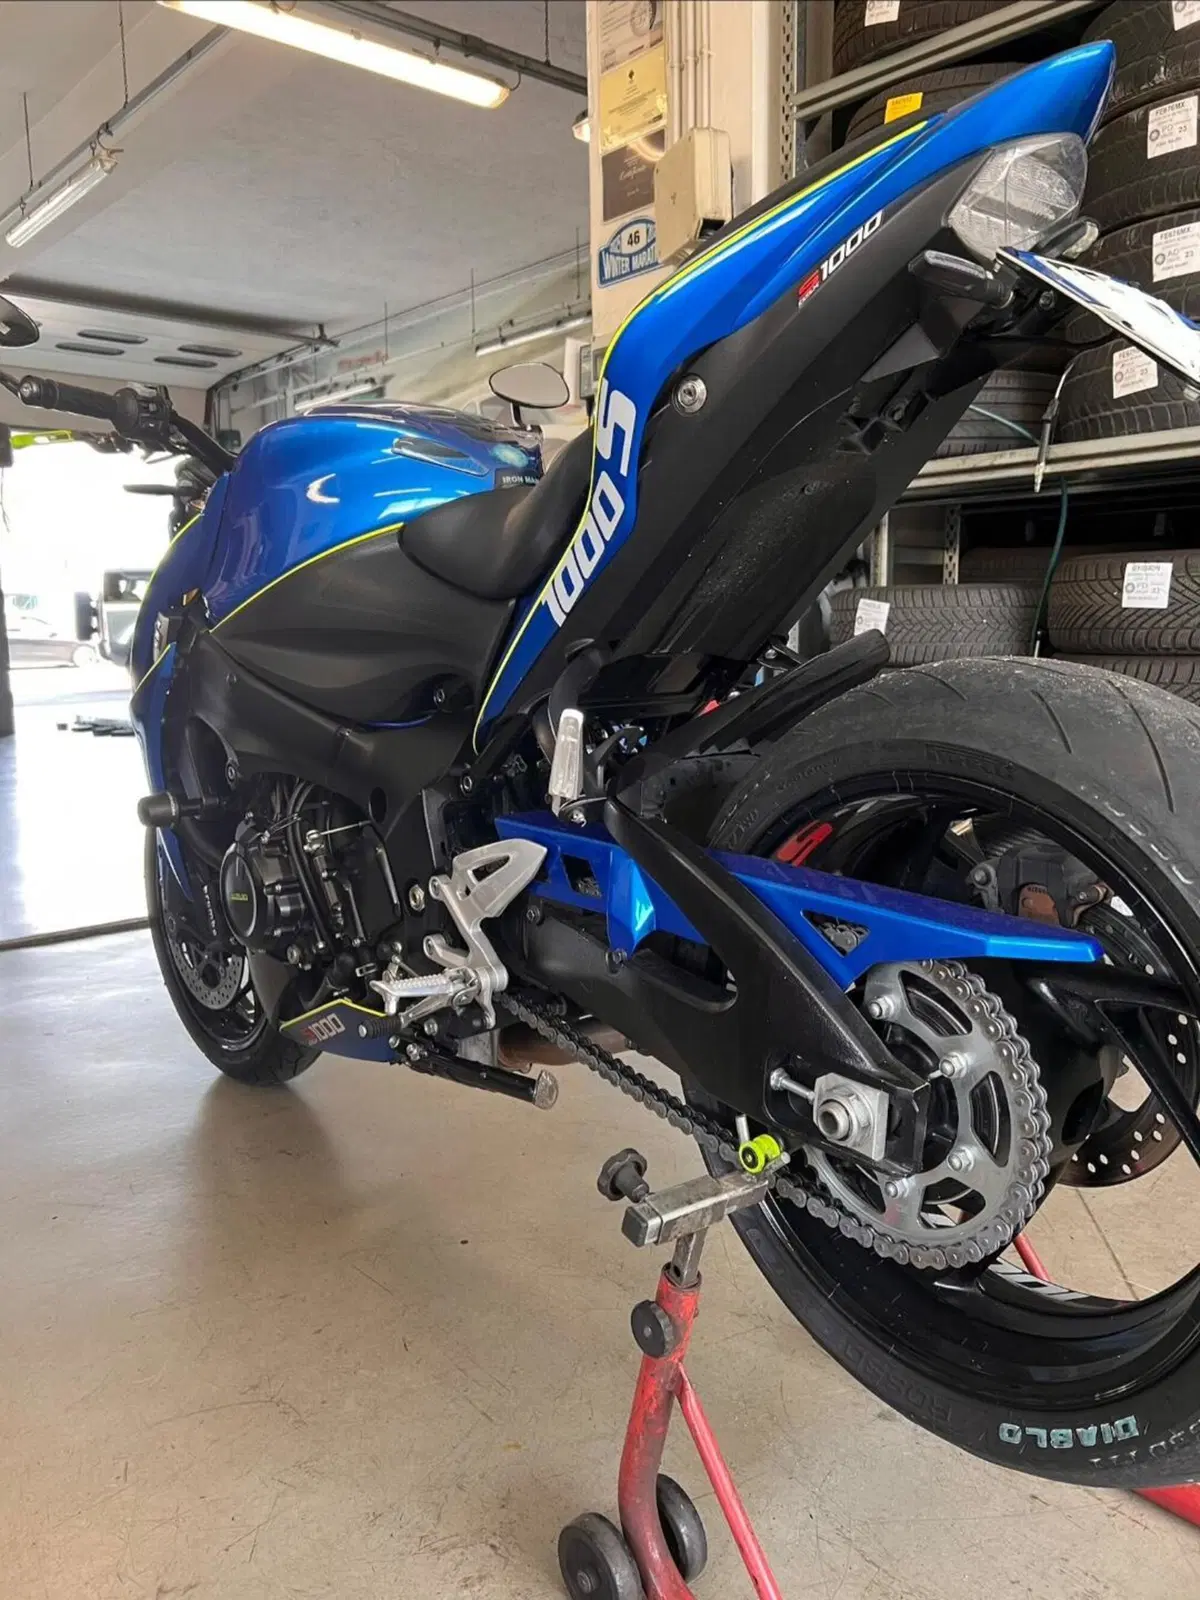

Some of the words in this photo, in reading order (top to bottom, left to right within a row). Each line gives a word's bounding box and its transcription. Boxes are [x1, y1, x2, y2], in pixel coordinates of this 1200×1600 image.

[627, 230, 641, 247] 46
[502, 476, 523, 484] IRON
[999, 1415, 1139, 1449] DIABLO
